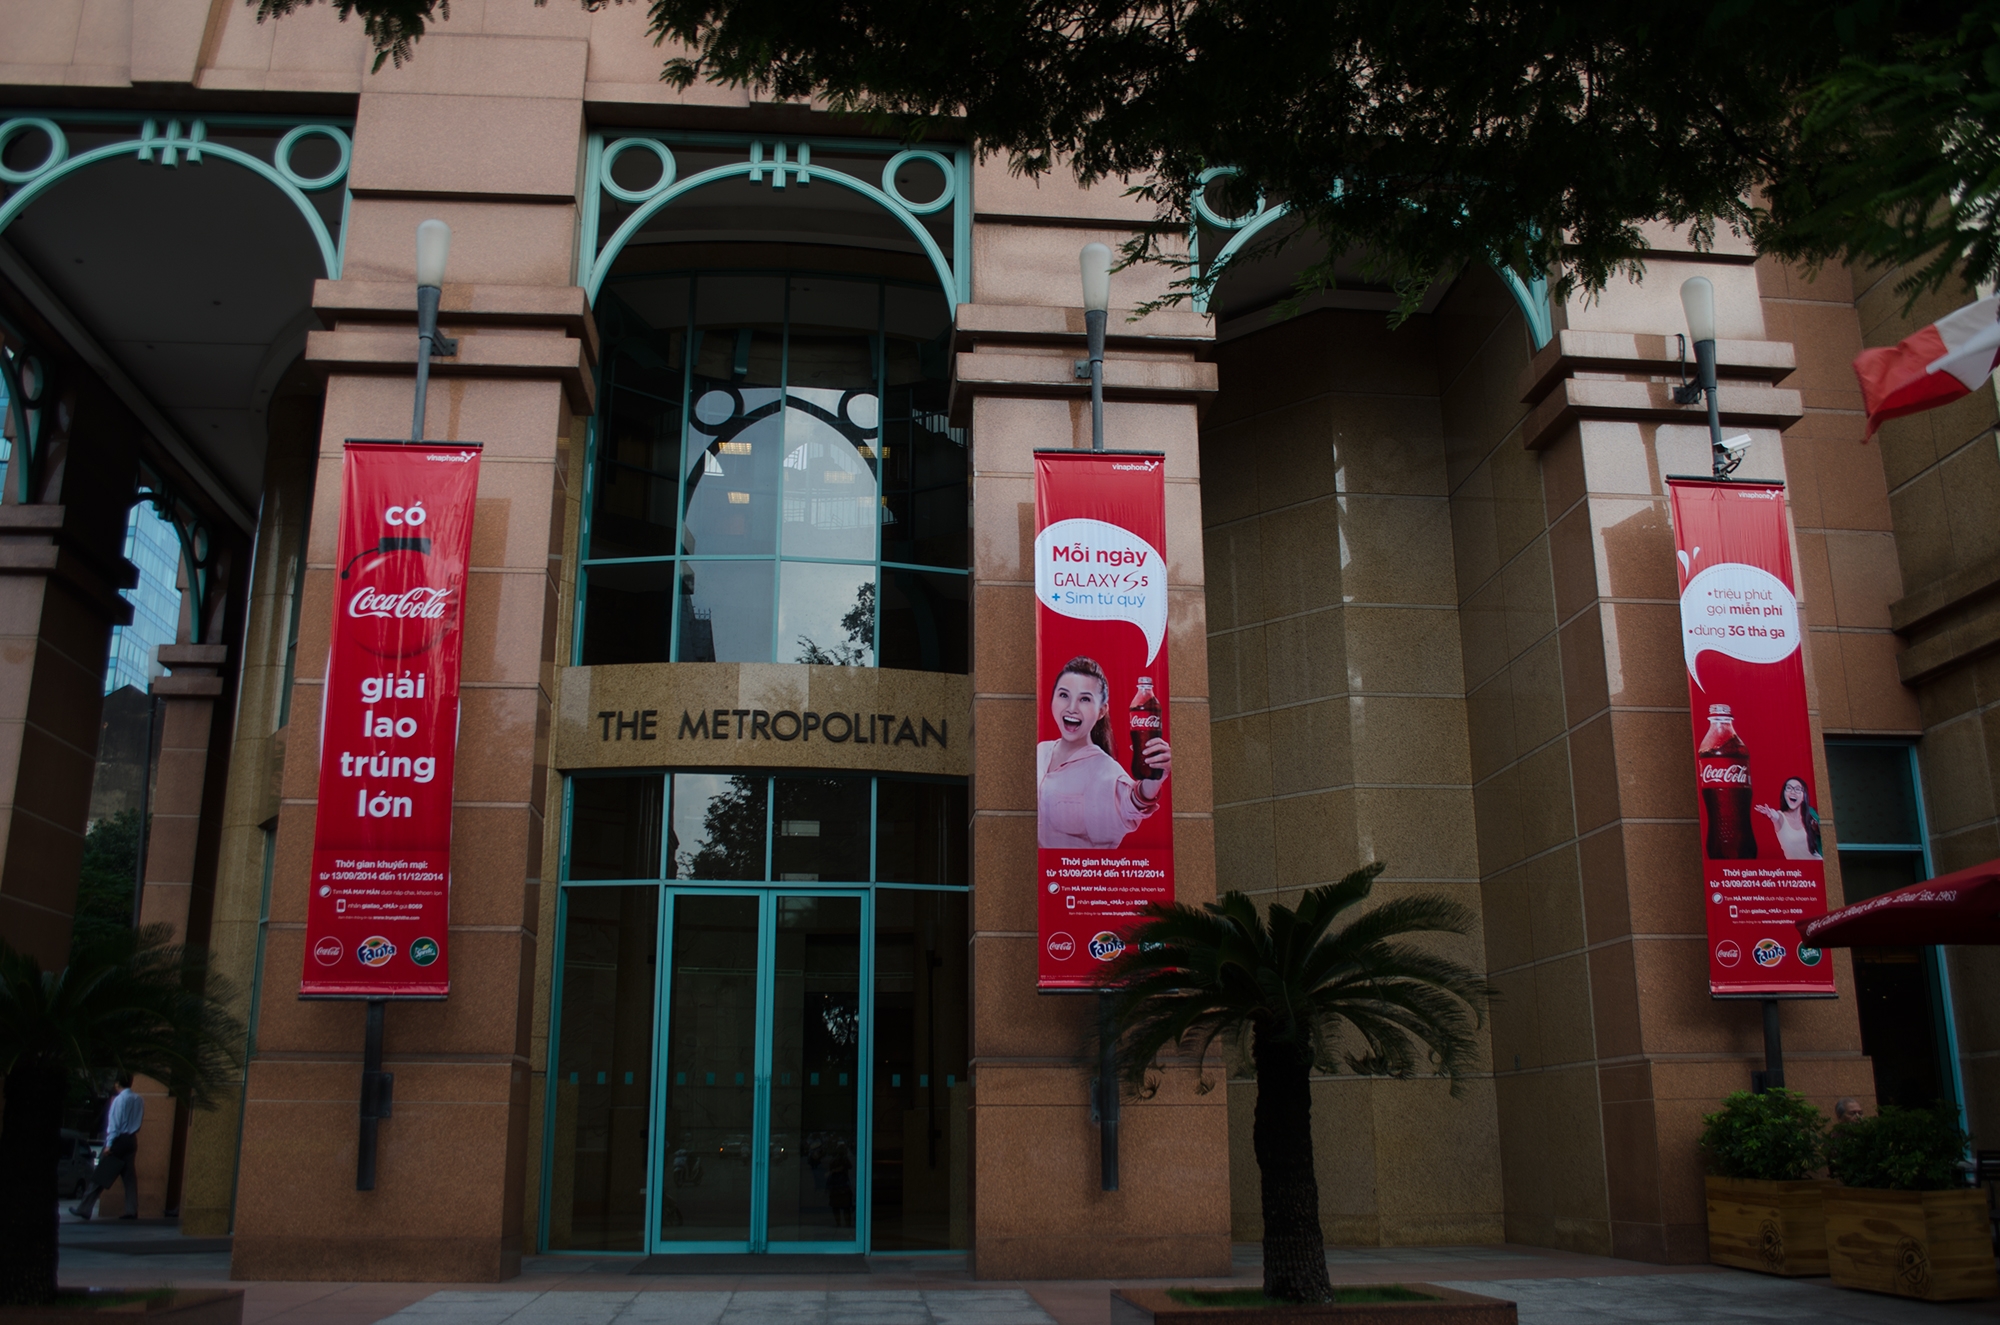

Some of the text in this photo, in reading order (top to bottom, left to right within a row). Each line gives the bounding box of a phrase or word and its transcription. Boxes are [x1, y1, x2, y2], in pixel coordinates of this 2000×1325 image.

[427, 454, 465, 463] vinaphone
[1112, 463, 1148, 471] vinaphone
[1738, 491, 1770, 500] vinaphone
[385, 501, 427, 526] có
[1052, 543, 1148, 568] Mỗi ngày
[1054, 572, 1120, 588] GALAXY
[348, 586, 454, 619] Coca-Cola
[1065, 591, 1093, 605] Sim
[1098, 592, 1114, 605] tứ
[1117, 592, 1146, 608] quý
[1713, 588, 1773, 602] triệu phút
[1706, 602, 1783, 618] gọi miễn phí
[1694, 624, 1785, 639] dùng 3G thả ga
[361, 670, 425, 704] giải
[364, 710, 418, 738] lao
[598, 709, 947, 749] THE METROPOLITAN
[1131, 715, 1160, 728] Coca-Cola
[340, 750, 436, 784] trúng
[1702, 764, 1747, 783] Coca-Cola
[358, 789, 413, 818] lớn
[335, 860, 355, 869] Thời
[356, 861, 375, 870] gian
[409, 861, 428, 870] mại:
[1061, 857, 1149, 867] Thời gian khuyến mại:
[320, 871, 444, 881] từ 13/09/2014 đến 11/12/2014
[1046, 869, 1165, 878] từ 13/09/2014 đến 11/12/2014
[1723, 868, 1802, 878] Thời gian khuyến mại:
[1710, 879, 1816, 888] từ 13/09/2014 đến 11/12/2014
[1935, 890, 1957, 901] 1963
[357, 943, 397, 965] Fanta
[1753, 944, 1786, 965] Fanta
